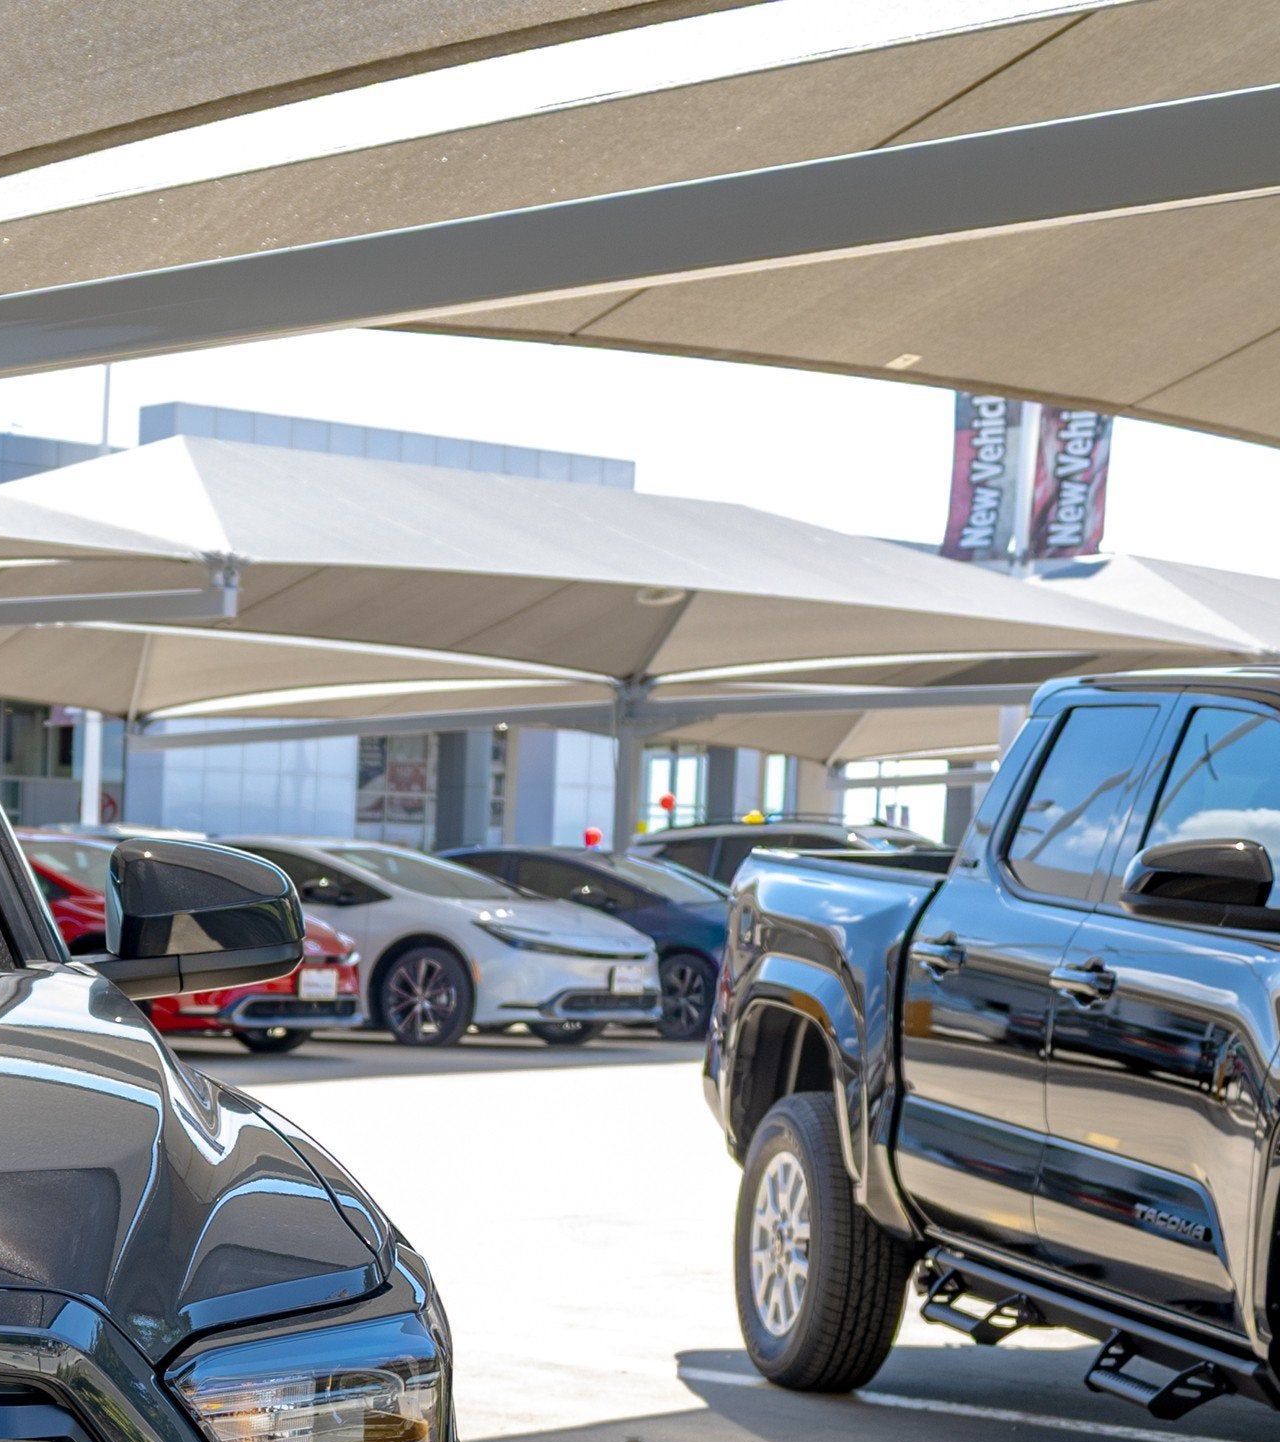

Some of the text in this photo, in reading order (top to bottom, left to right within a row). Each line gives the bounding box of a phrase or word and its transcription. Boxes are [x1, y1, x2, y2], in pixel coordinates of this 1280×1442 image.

[959, 487, 1000, 548] New
[1047, 481, 1088, 546] New
[1134, 1203, 1206, 1240] TACOMA
